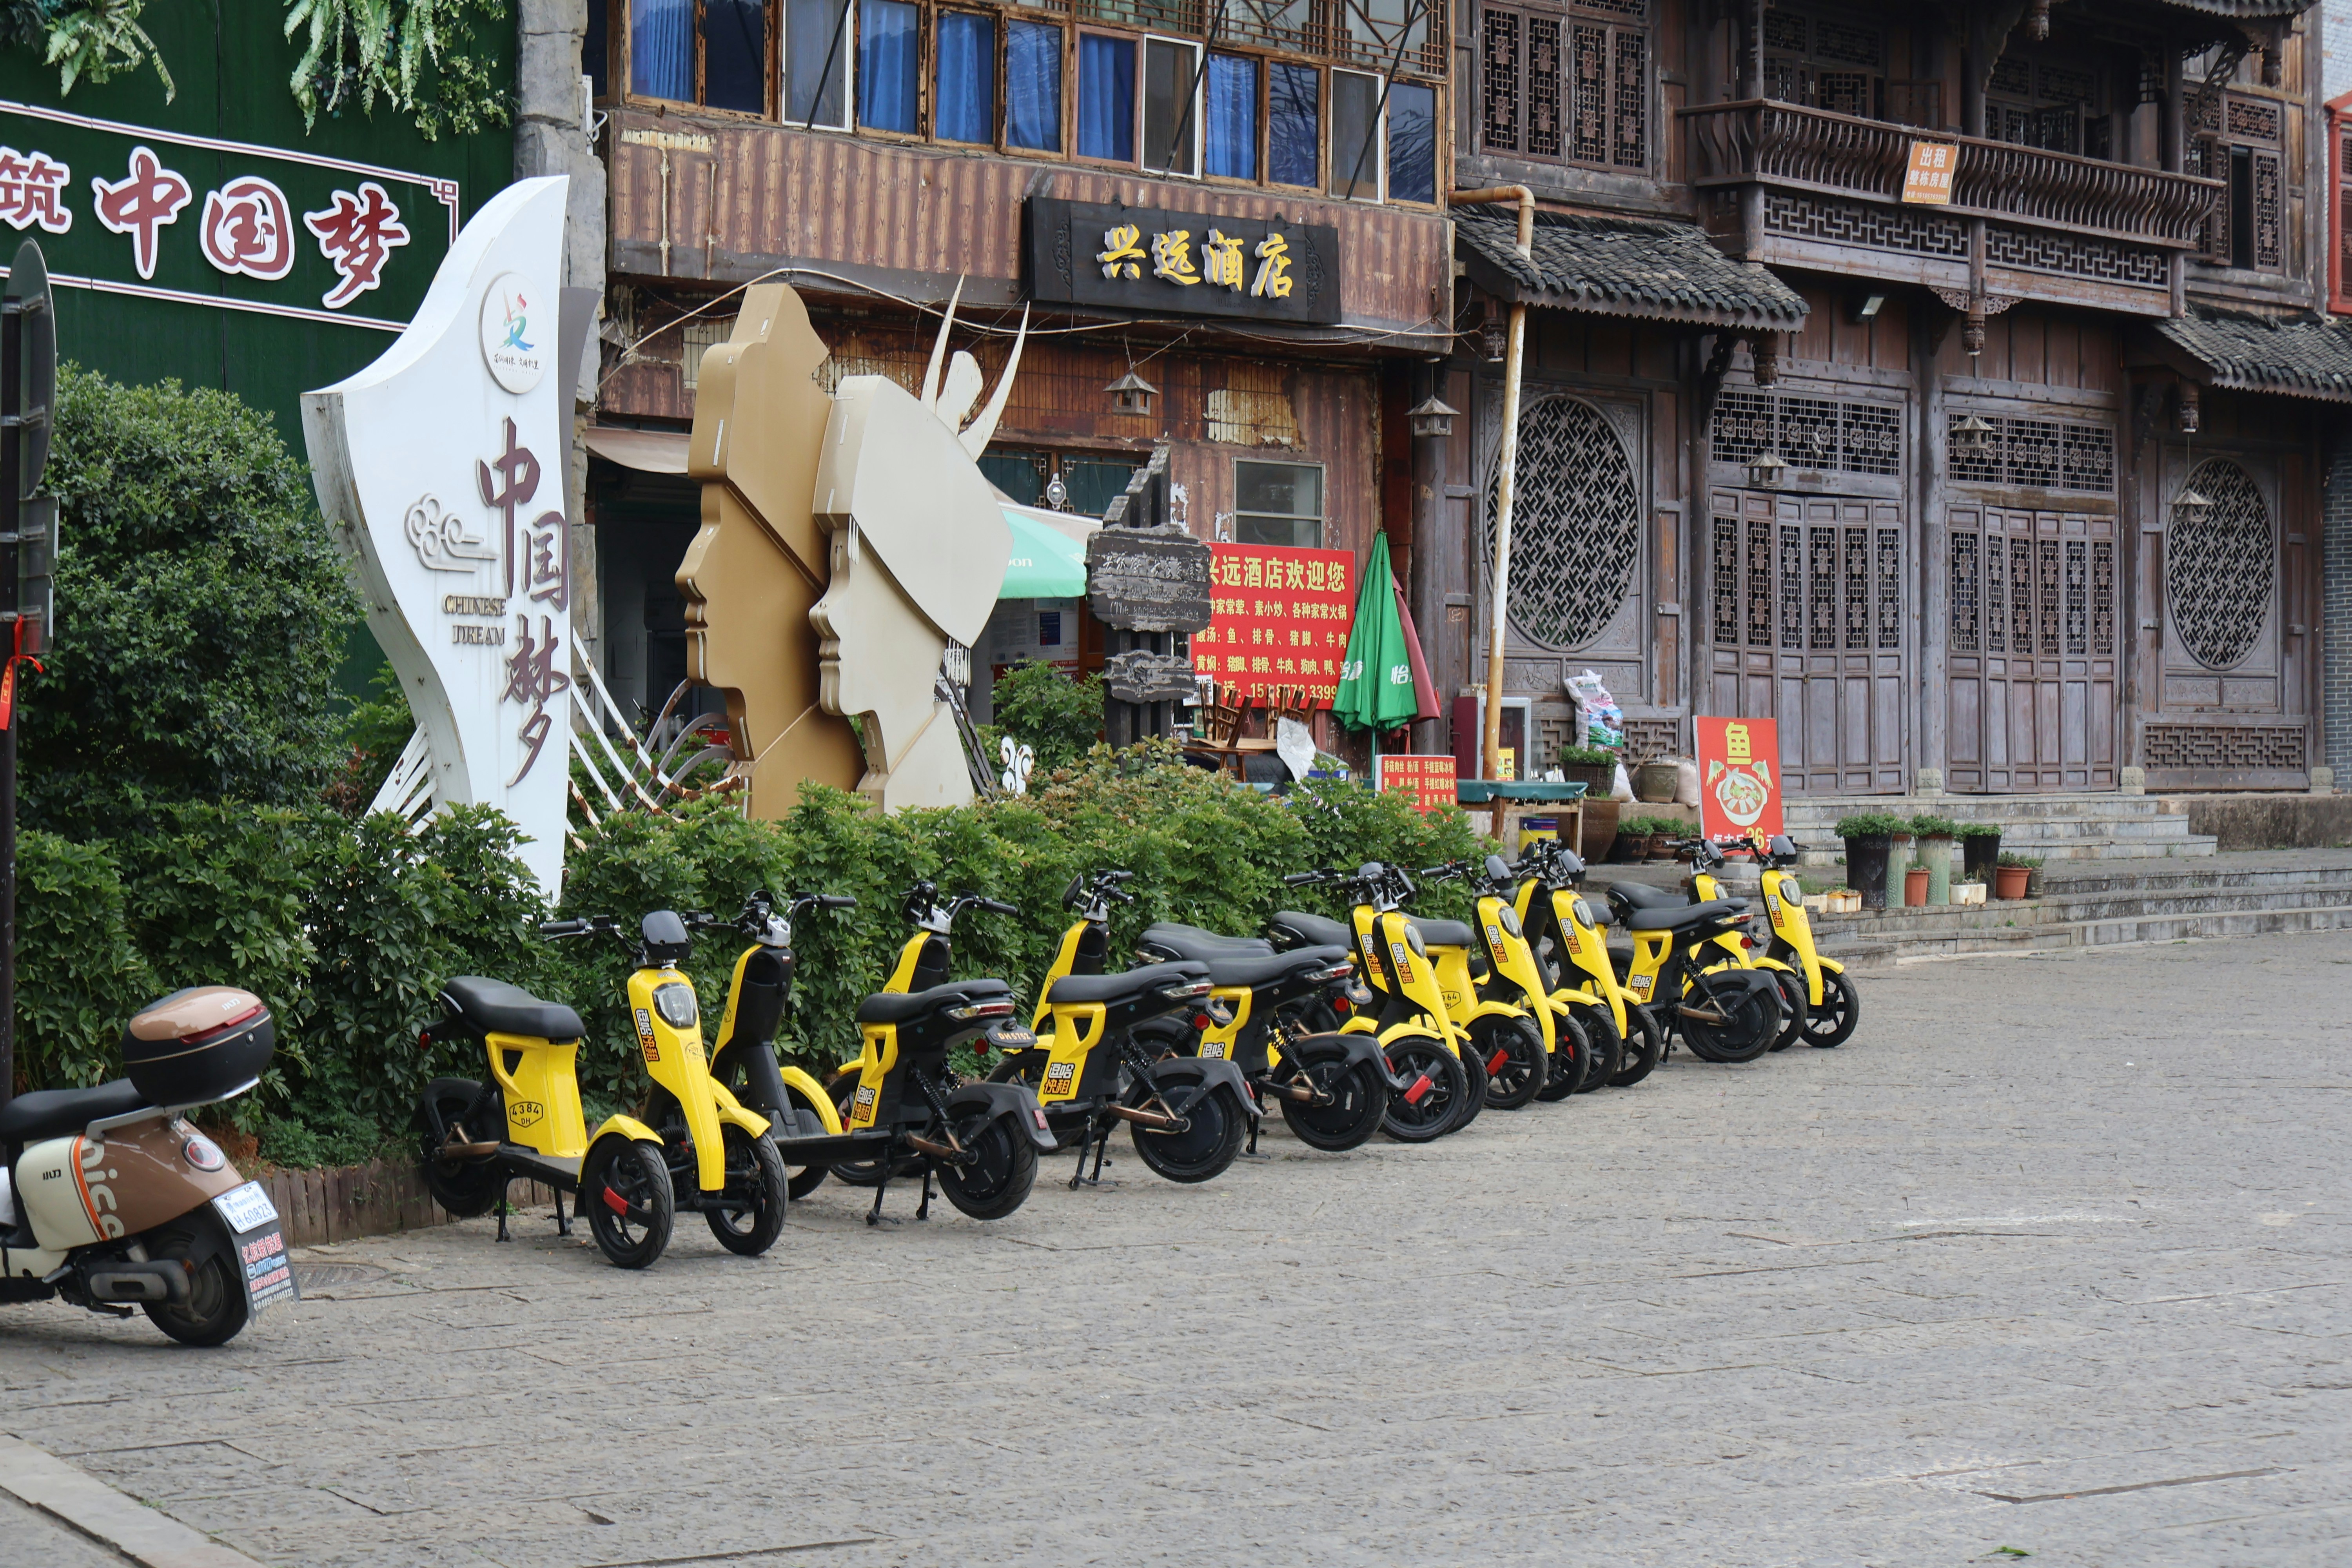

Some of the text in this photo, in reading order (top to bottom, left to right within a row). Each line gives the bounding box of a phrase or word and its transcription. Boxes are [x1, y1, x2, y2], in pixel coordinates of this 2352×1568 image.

[1920, 147, 1947, 168] 出租
[1909, 170, 1950, 188] 整栋房屋
[1097, 223, 1293, 299] 兴远酒店
[443, 594, 506, 616] CHINESE
[475, 416, 570, 787] 中国梦
[452, 624, 505, 645] DREAM
[1390, 664, 1413, 685] 怡
[1726, 722, 1752, 765] 鱼
[1384, 760, 1405, 773] 香菇肉丝
[1407, 761, 1419, 773] 粉/面
[512, 1103, 539, 1116] 4384
[242, 1232, 283, 1265] 亿航新能源
